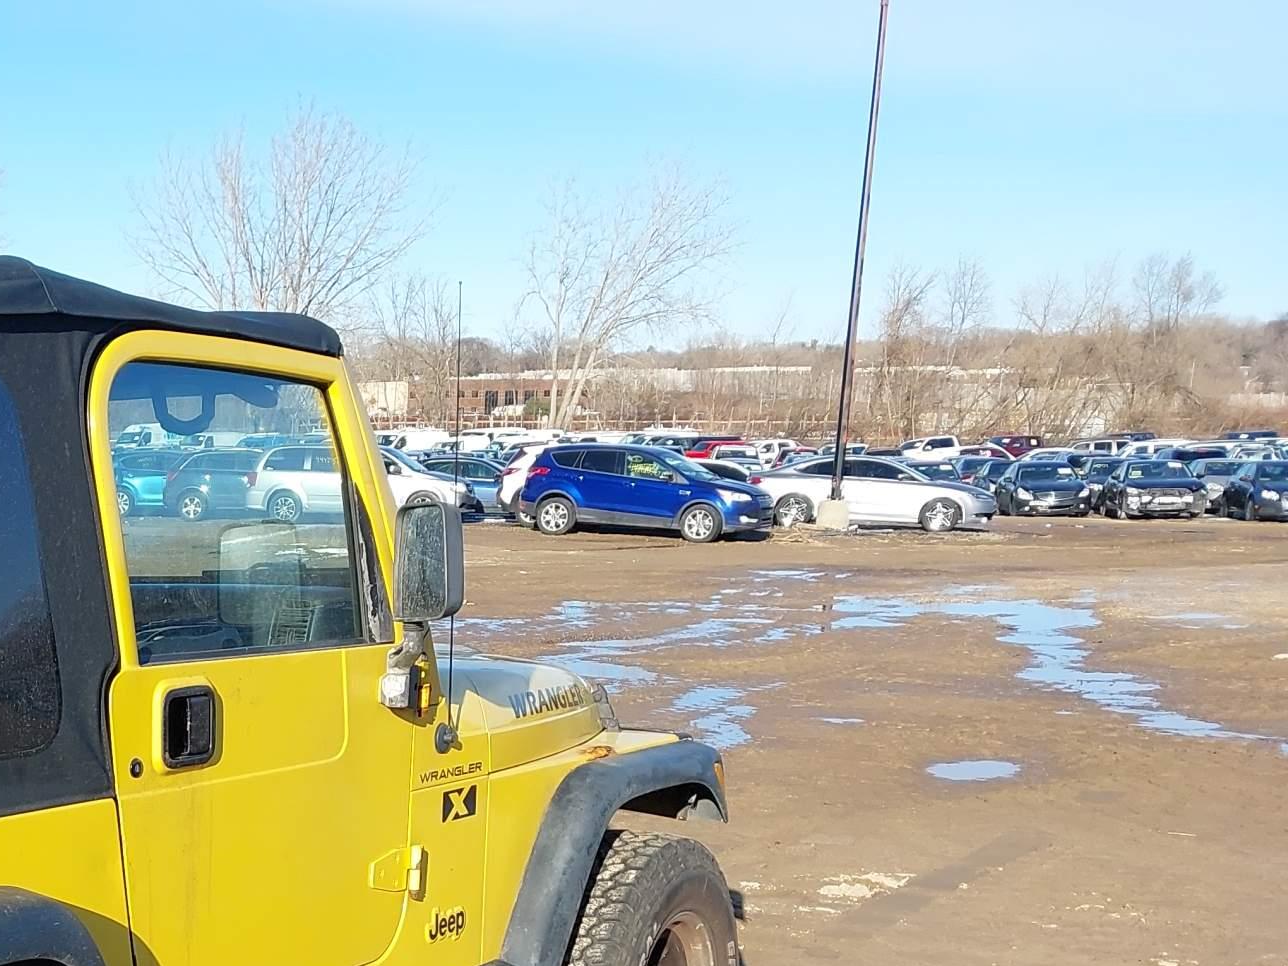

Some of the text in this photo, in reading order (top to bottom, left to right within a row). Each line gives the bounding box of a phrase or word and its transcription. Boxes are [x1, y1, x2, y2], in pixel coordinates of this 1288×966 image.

[508, 683, 584, 719] WRANGLER
[419, 761, 483, 784] WRANGLER
[443, 785, 475, 823] X
[429, 910, 465, 941] Jeep
